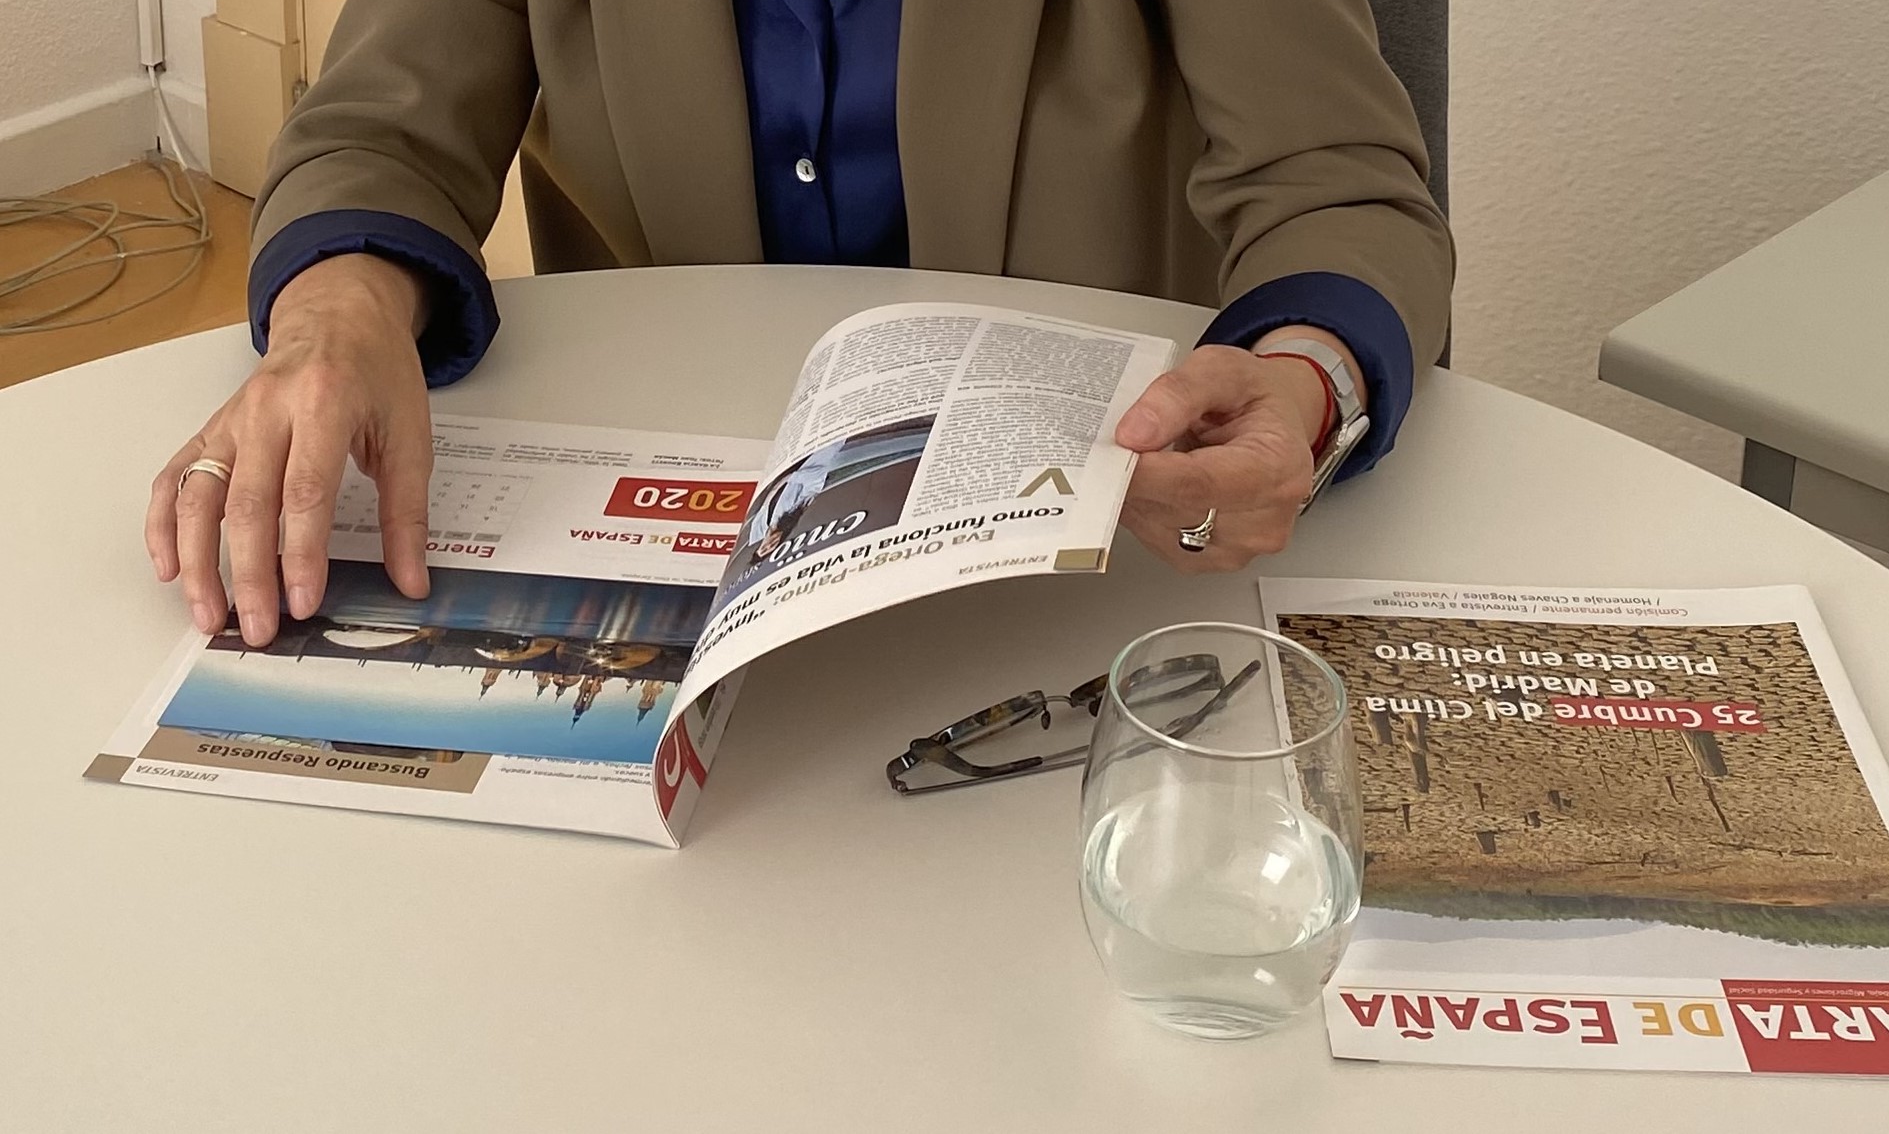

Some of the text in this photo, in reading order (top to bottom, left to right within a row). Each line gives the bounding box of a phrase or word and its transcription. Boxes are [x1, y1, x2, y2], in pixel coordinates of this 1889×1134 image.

[1015, 467, 1075, 499] V
[633, 486, 744, 512] 2020
[991, 507, 1064, 523] como
[569, 529, 644, 545] ESPAÑA
[649, 535, 673, 545] DE
[878, 515, 986, 550] funciona
[951, 529, 995, 546] Eva
[425, 542, 496, 559] Enero
[850, 544, 872, 560] la
[797, 554, 845, 580] vida
[958, 554, 1048, 575] ENTREVISTA
[765, 576, 792, 596] es
[1372, 598, 1420, 609] Ortega
[1392, 590, 1450, 601] Valencia
[1462, 592, 1518, 603] Nogales
[1519, 593, 1570, 605] Chaves
[1583, 595, 1652, 606] Homenaje
[717, 591, 762, 629] muy
[1421, 600, 1446, 611] Eva
[1460, 602, 1529, 614] Entrevista
[1540, 604, 1623, 617] permanente
[1624, 606, 1689, 618] Comisión
[1374, 641, 1720, 676] Planeta en peligro
[1451, 672, 1656, 700] de Madrid:
[1365, 696, 1761, 728] 25 Cumbre del Clima
[196, 742, 432, 780] Buscando Respuestas
[135, 764, 220, 783] ENTREVISTA
[1338, 993, 1620, 1045] ESPAÑA
[1632, 1002, 1725, 1038] DE
